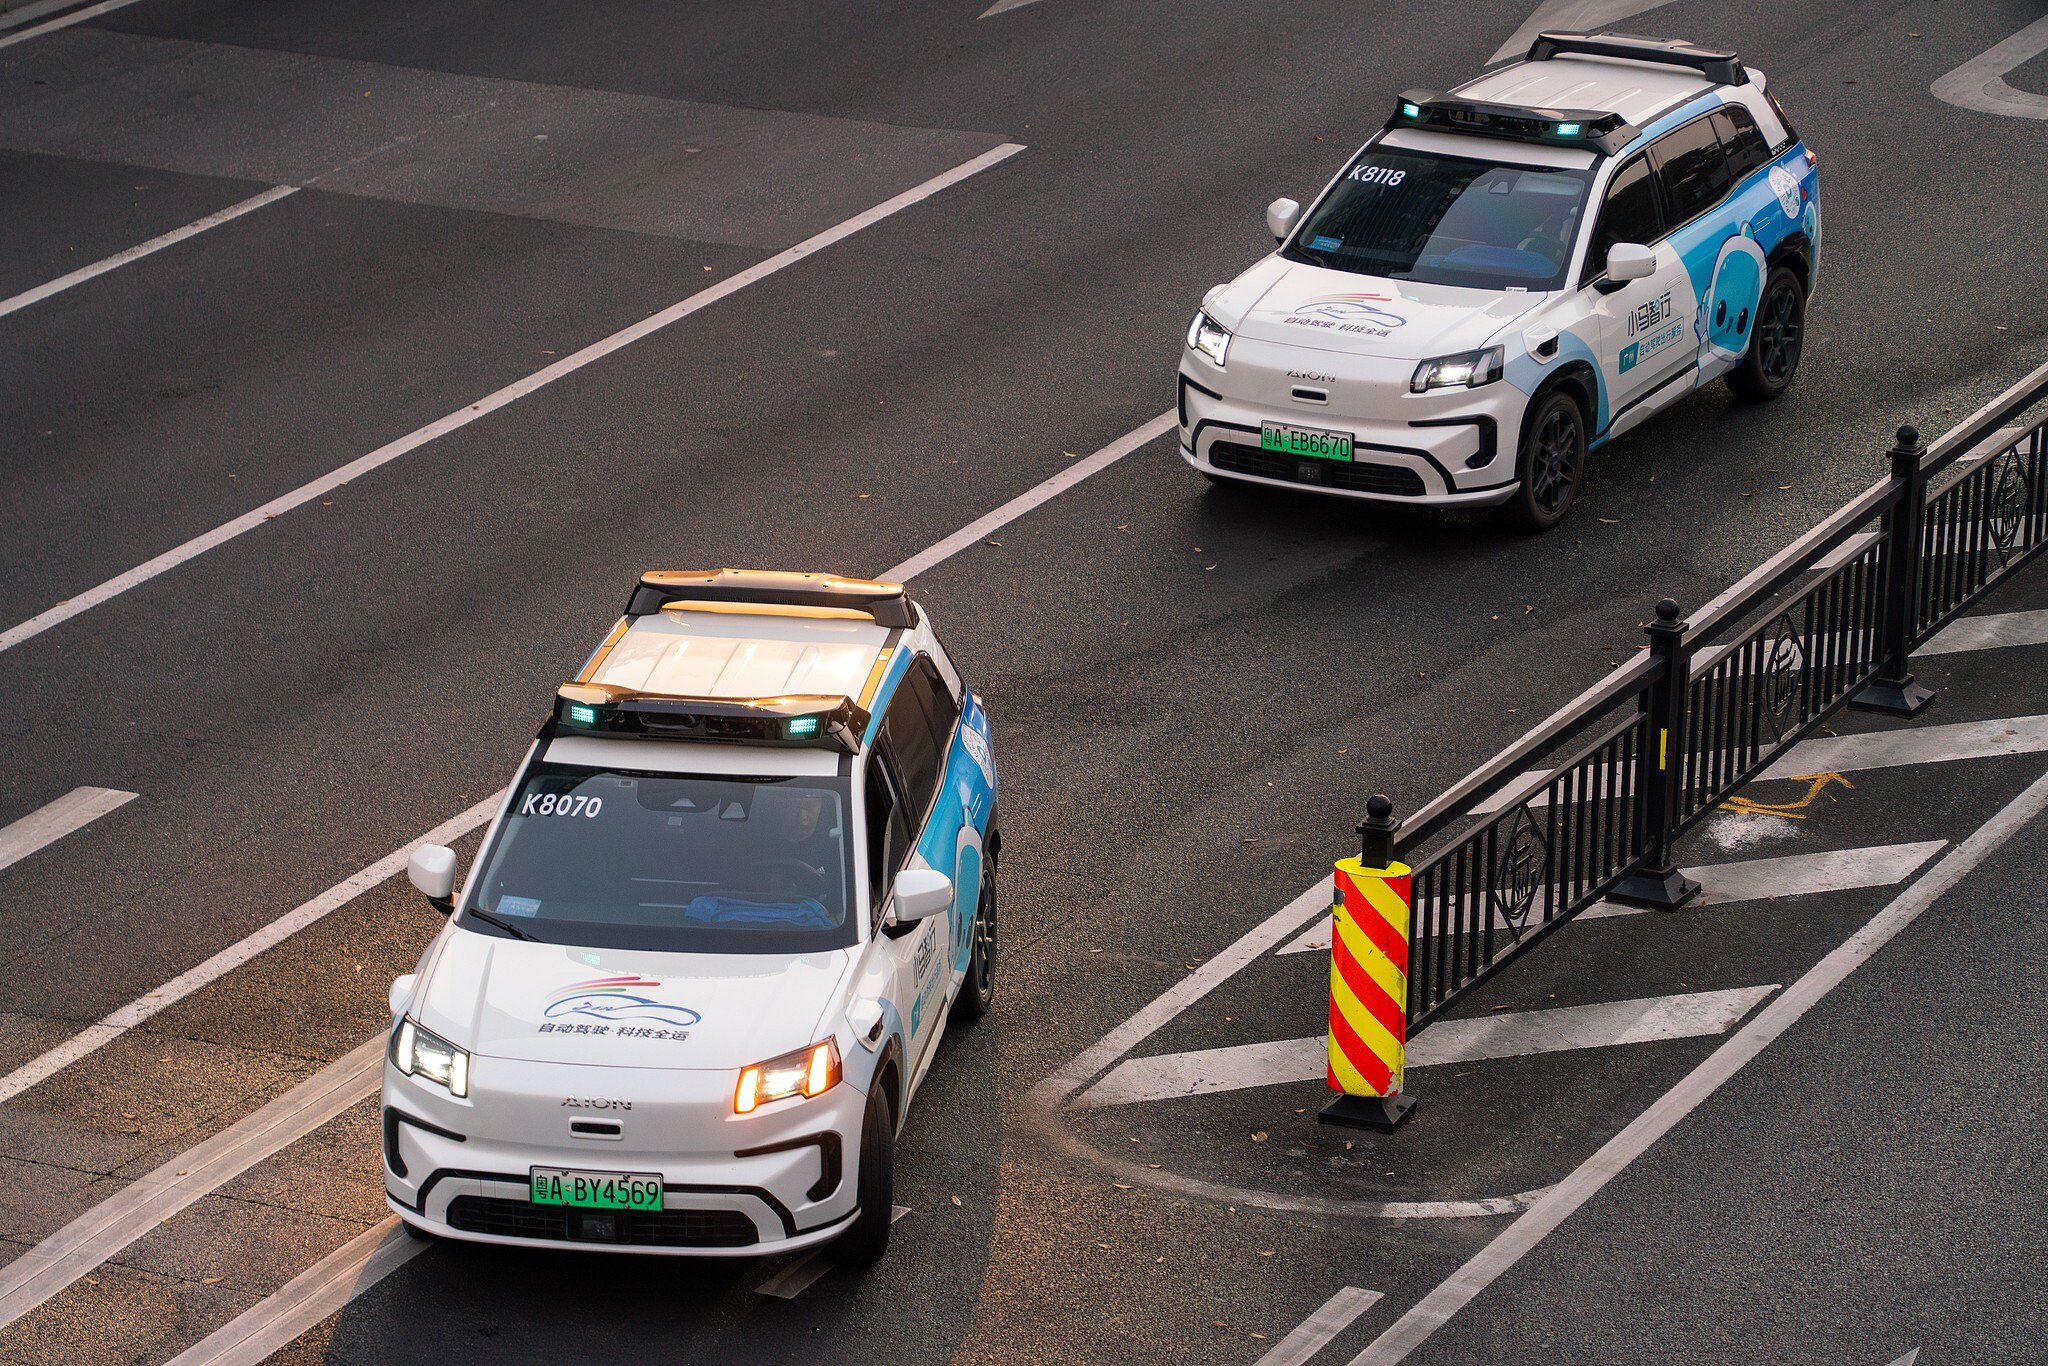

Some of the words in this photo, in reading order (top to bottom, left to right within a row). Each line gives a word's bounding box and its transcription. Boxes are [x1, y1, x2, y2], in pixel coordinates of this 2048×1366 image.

[1347, 165, 1406, 186] K8118
[1627, 291, 1671, 337] 小马智行
[1286, 368, 1336, 382] AION
[521, 793, 603, 818] K8070
[561, 1095, 632, 1110] AION
